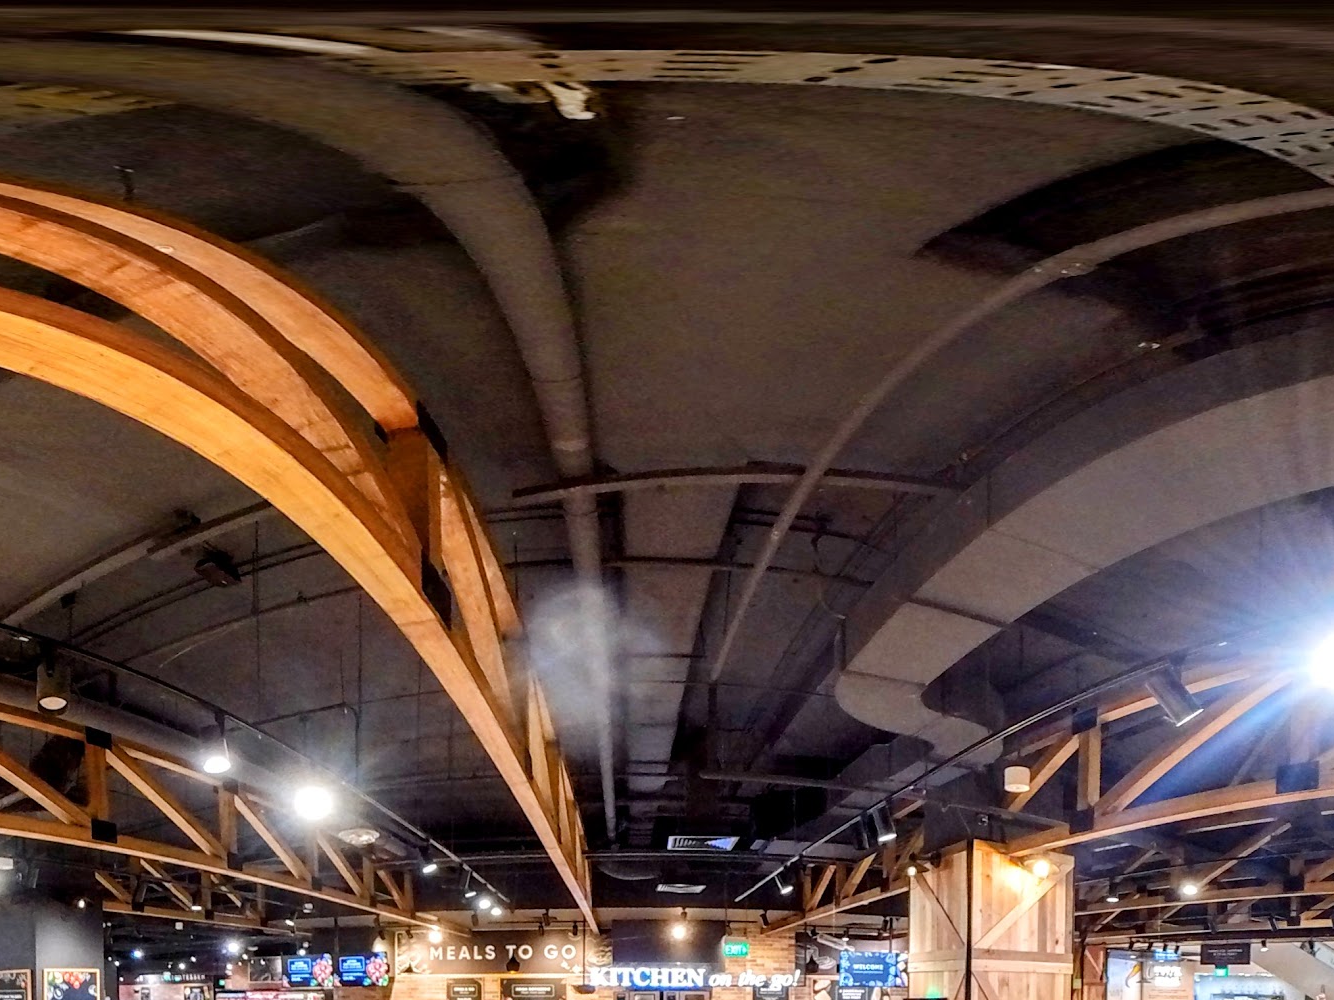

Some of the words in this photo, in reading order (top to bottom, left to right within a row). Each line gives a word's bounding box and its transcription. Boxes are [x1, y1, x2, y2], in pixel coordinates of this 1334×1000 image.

[429, 945, 496, 960] MEALS
[505, 944, 533, 960] TO
[543, 944, 577, 960] GO
[725, 945, 742, 955] EXIT
[589, 966, 706, 988] KITCHEN
[708, 974, 733, 987] on
[738, 969, 766, 987] the
[768, 969, 801, 991] go!
